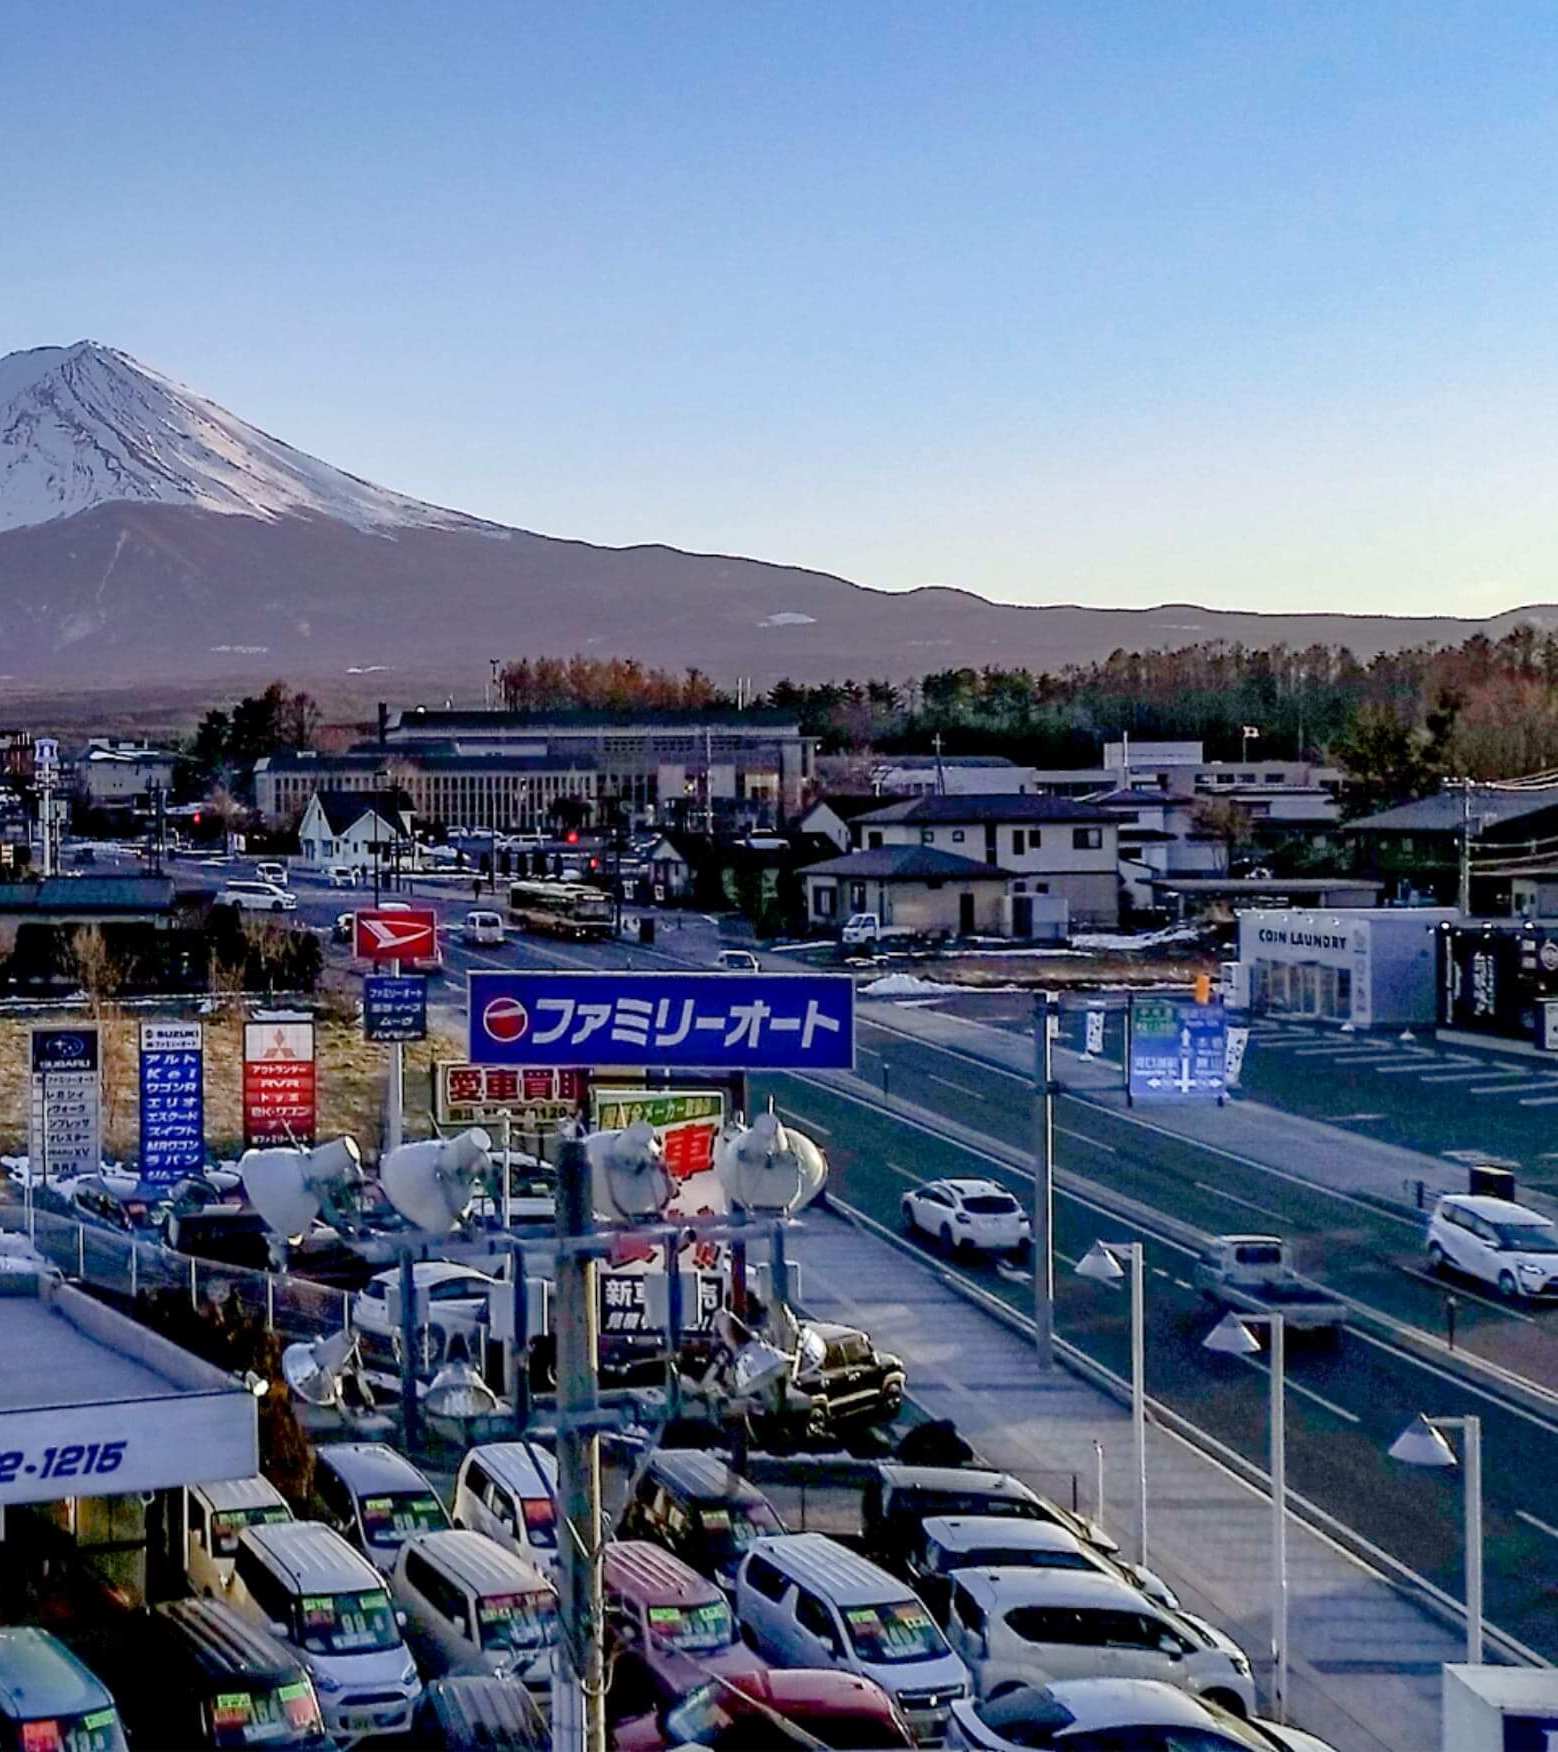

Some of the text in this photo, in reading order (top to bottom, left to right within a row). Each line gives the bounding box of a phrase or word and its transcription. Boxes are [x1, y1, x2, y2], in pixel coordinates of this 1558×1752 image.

[1258, 929, 1347, 949] COIN LAUNDRY
[531, 998, 840, 1049] ファミリーオート
[156, 1030, 199, 1038] SUZUKI
[40, 1059, 90, 1068] SUBARU
[146, 1054, 197, 1065] アルト
[146, 1083, 197, 1093] ワゴンR
[260, 1079, 300, 1088] RVR
[147, 1097, 197, 1108] エリオ
[147, 1112, 198, 1122] エスクード
[148, 1126, 198, 1137] スイフト
